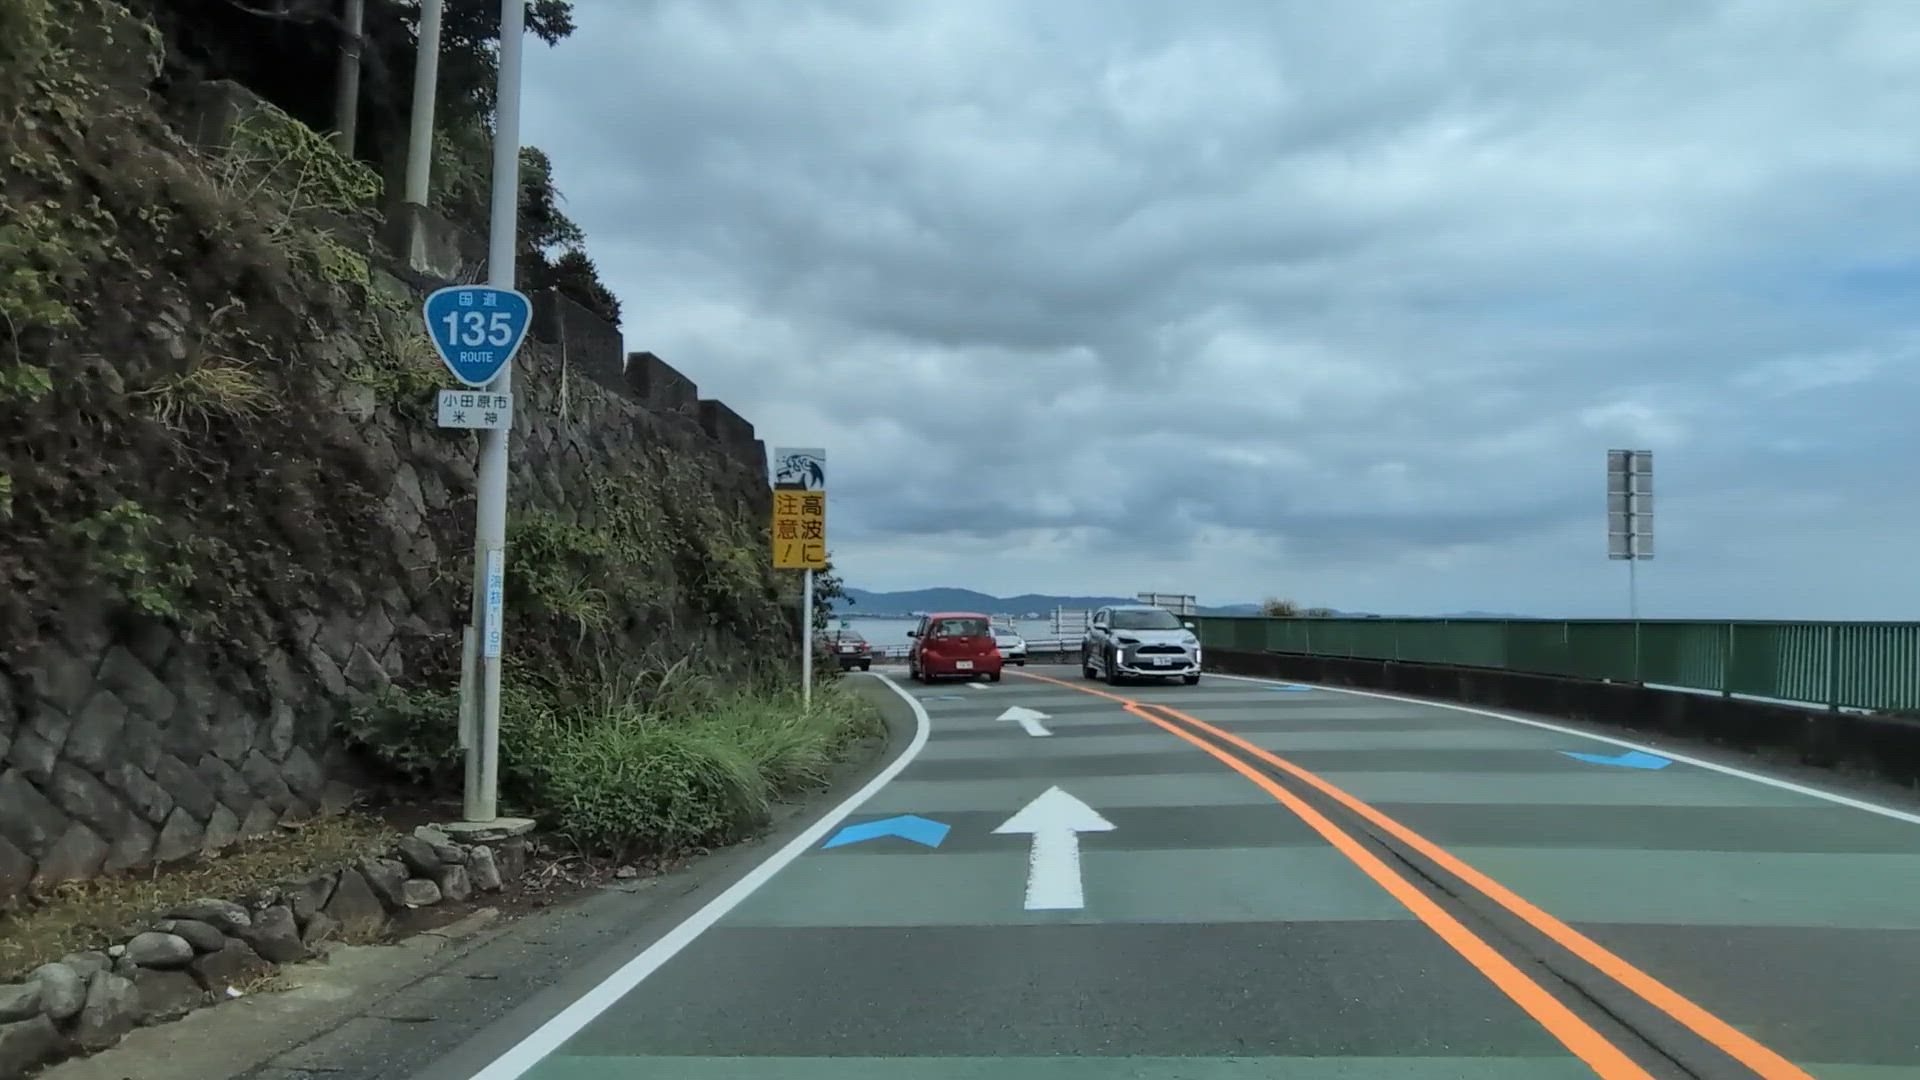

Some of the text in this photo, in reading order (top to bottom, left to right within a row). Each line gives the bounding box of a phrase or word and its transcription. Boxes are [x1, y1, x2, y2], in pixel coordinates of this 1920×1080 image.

[459, 292, 497, 307] 国道
[443, 311, 513, 347] 135
[460, 351, 494, 363] ROUTE
[443, 394, 508, 409] 小田原市
[453, 410, 498, 425] 米神
[801, 495, 823, 563] 高波に
